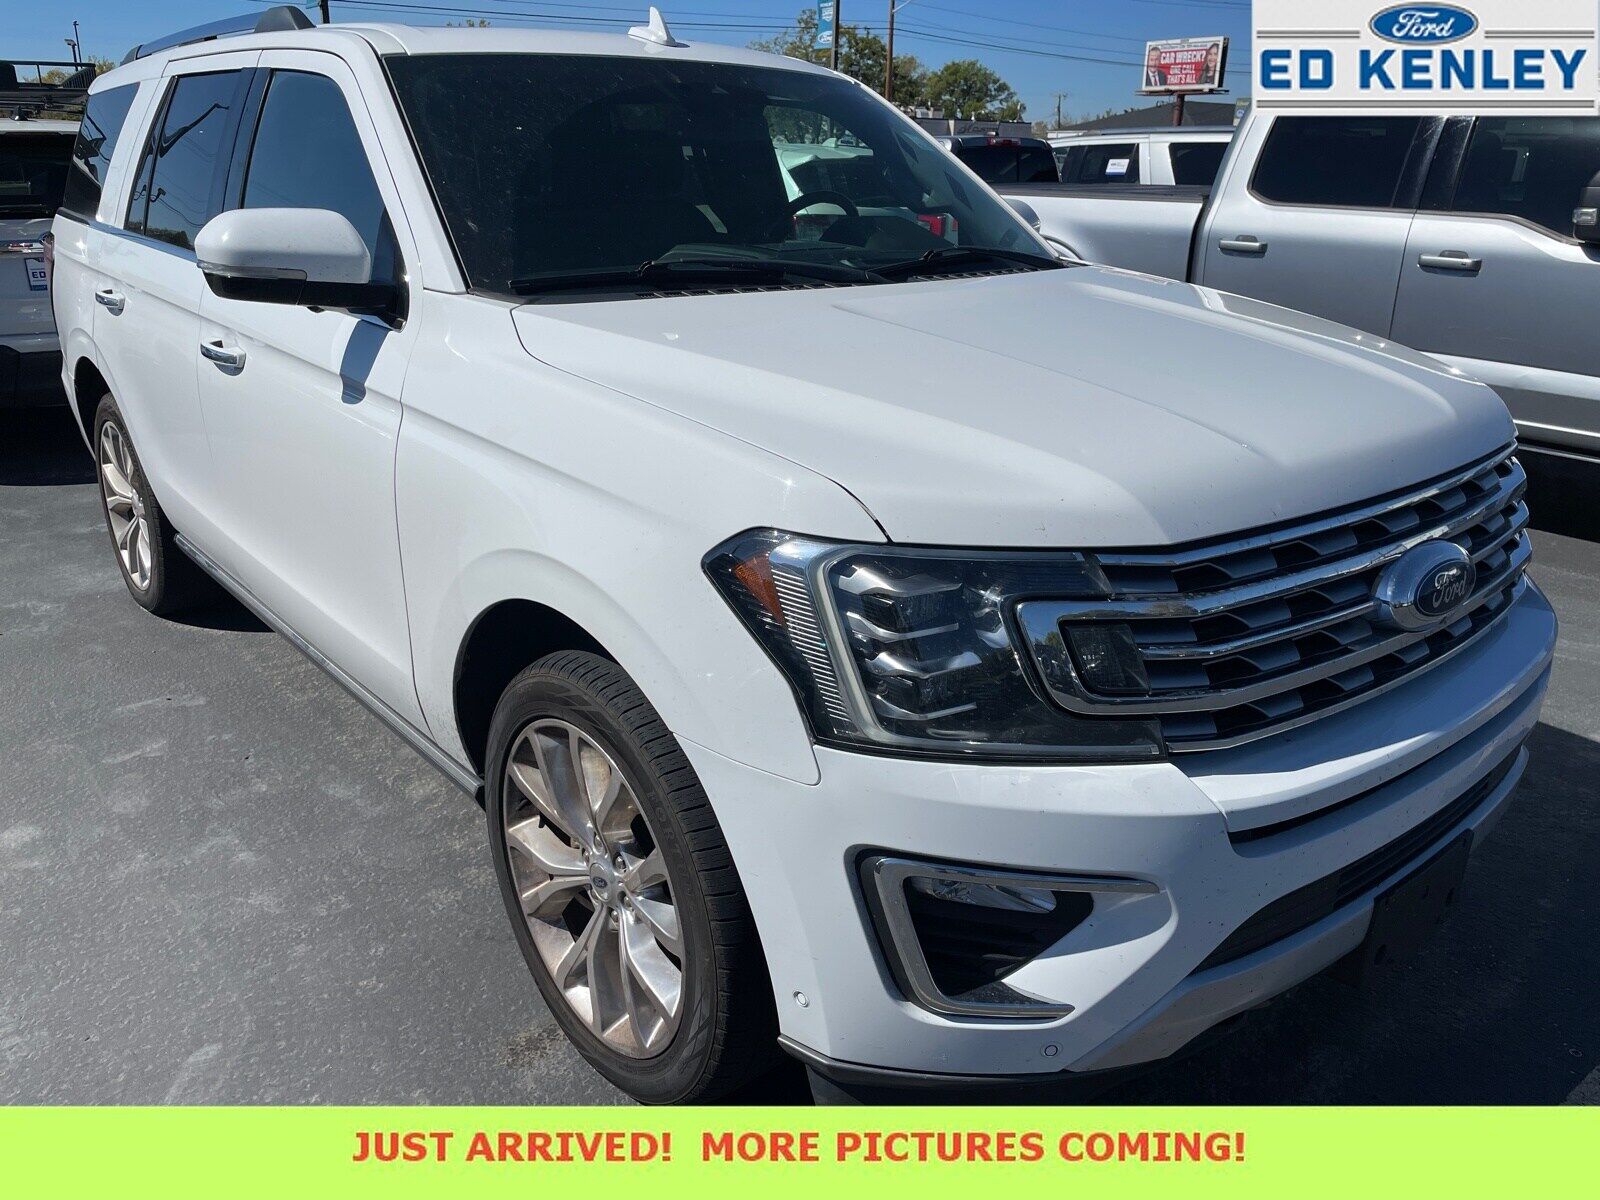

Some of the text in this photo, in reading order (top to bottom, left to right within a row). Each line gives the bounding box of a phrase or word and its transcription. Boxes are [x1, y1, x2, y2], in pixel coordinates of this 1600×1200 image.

[1161, 51, 1206, 64] CAR WRECK?
[1182, 65, 1195, 73] CALL
[1167, 74, 1196, 84] THAT'S ALL
[1432, 567, 1467, 608] Ford
